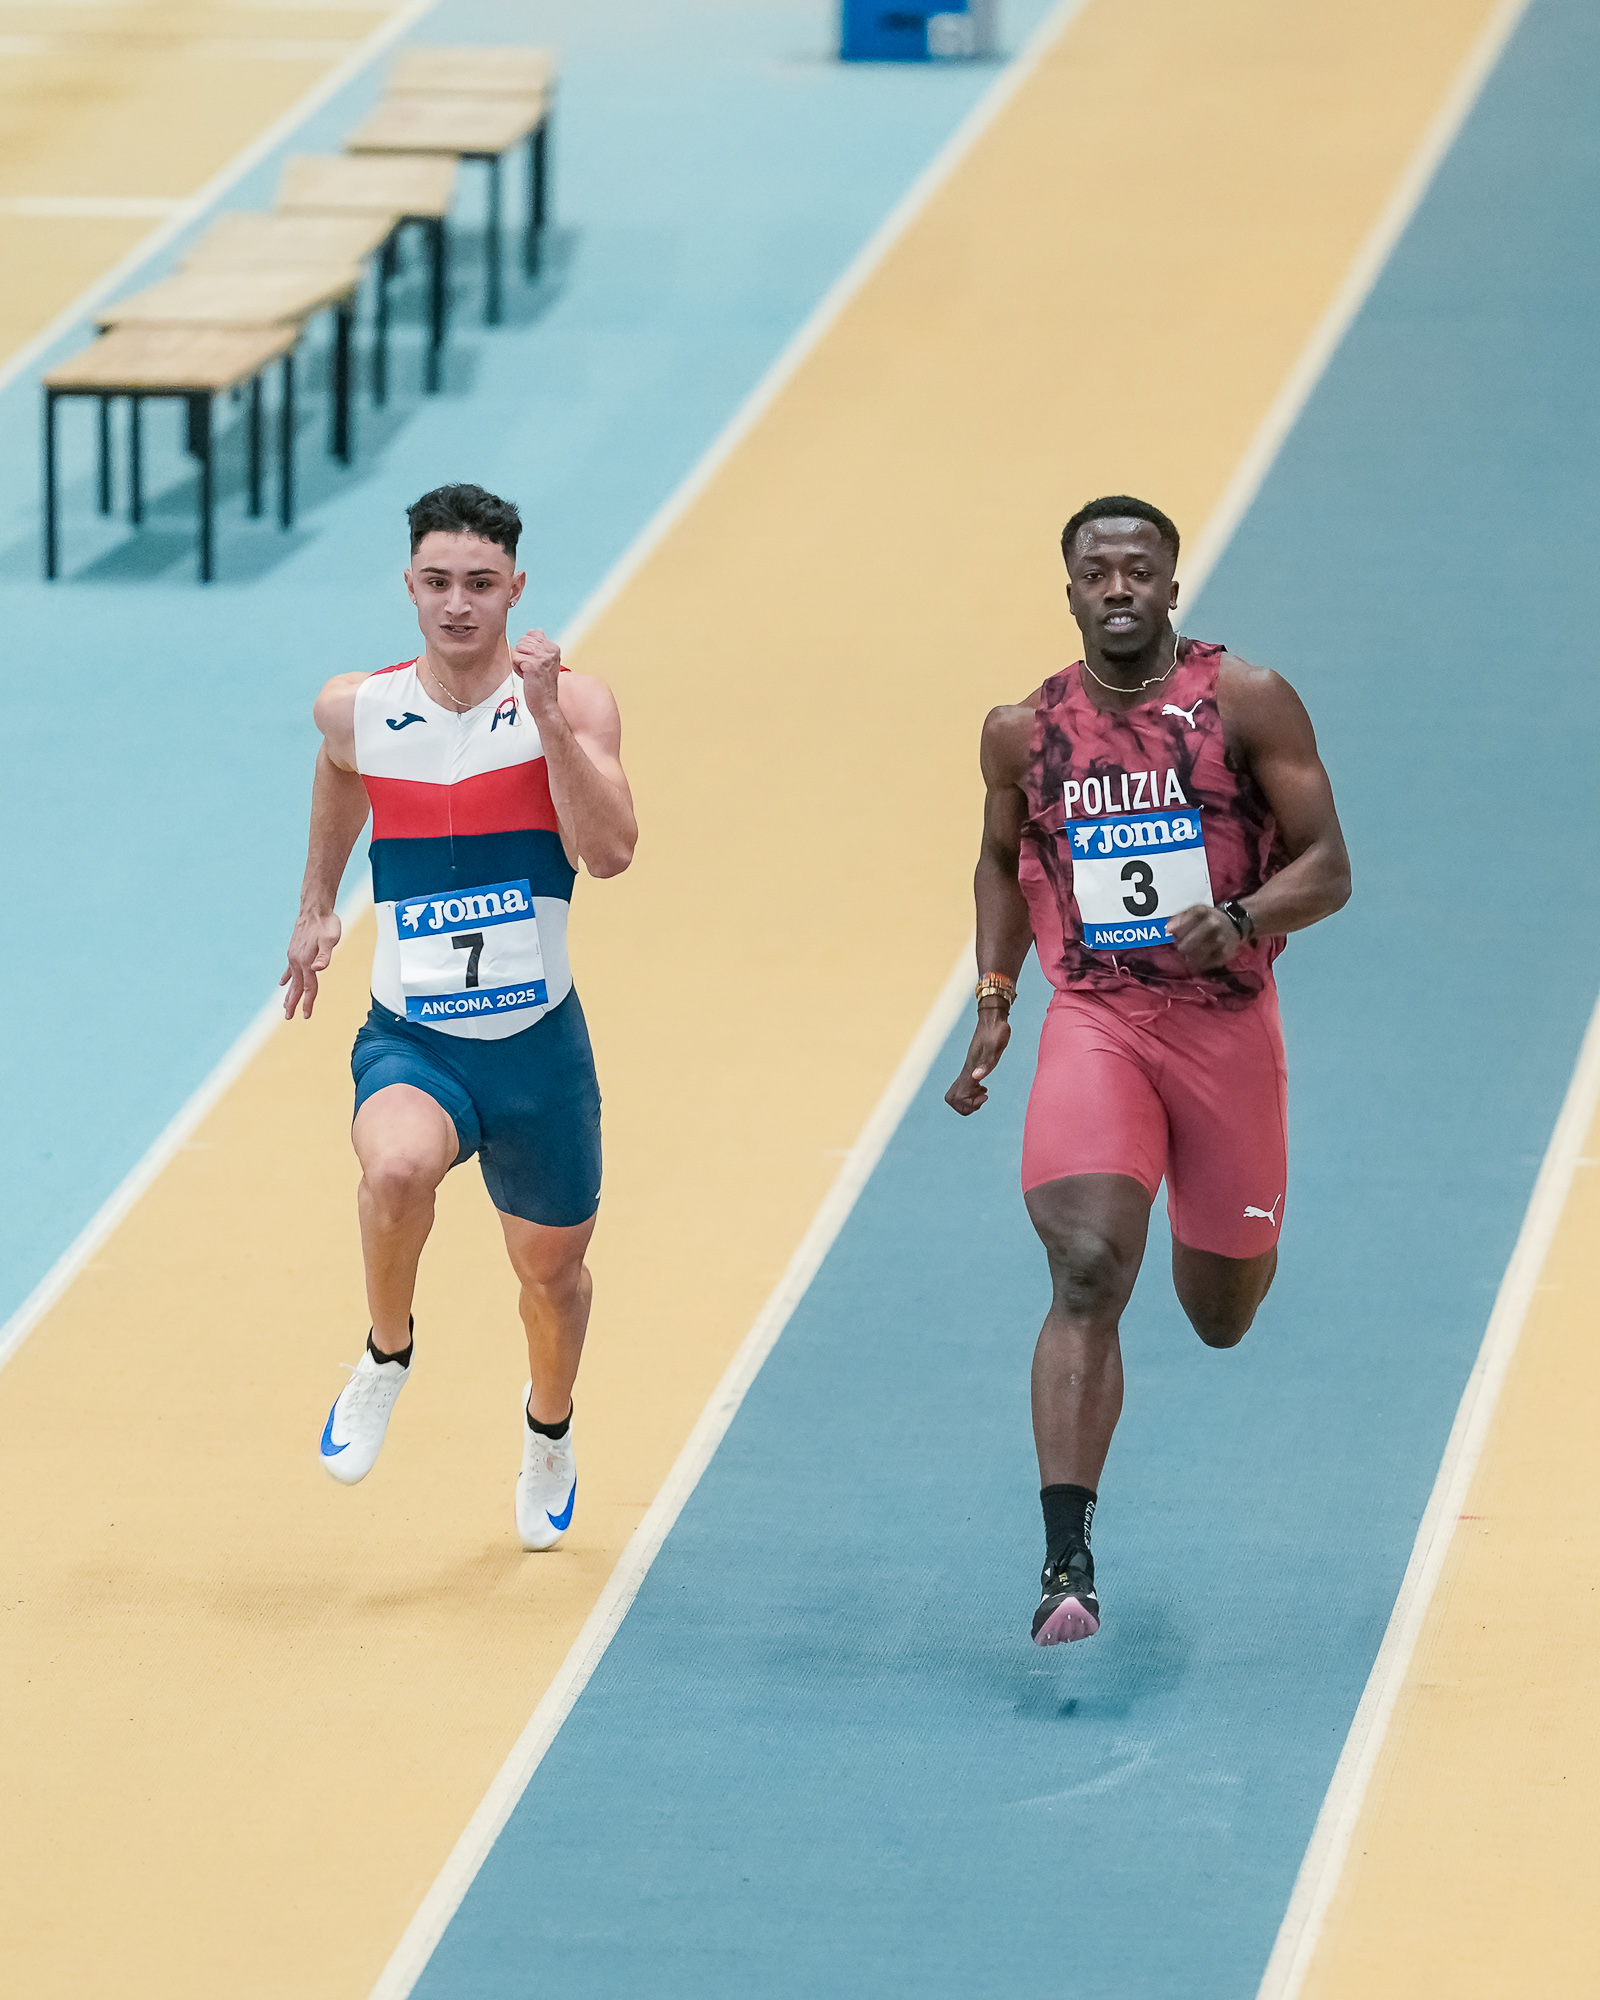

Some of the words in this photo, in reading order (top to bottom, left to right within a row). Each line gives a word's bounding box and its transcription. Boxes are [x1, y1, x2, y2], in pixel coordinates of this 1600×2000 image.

[1063, 768, 1187, 818] POLIZIA
[1097, 817, 1197, 854] Joma
[1120, 860, 1159, 917] 3
[428, 889, 529, 929] Joma
[1095, 926, 1161, 944] ANCONA
[451, 932, 484, 988] 7
[421, 996, 493, 1015] ANCONA
[496, 989, 536, 1008] 2025
